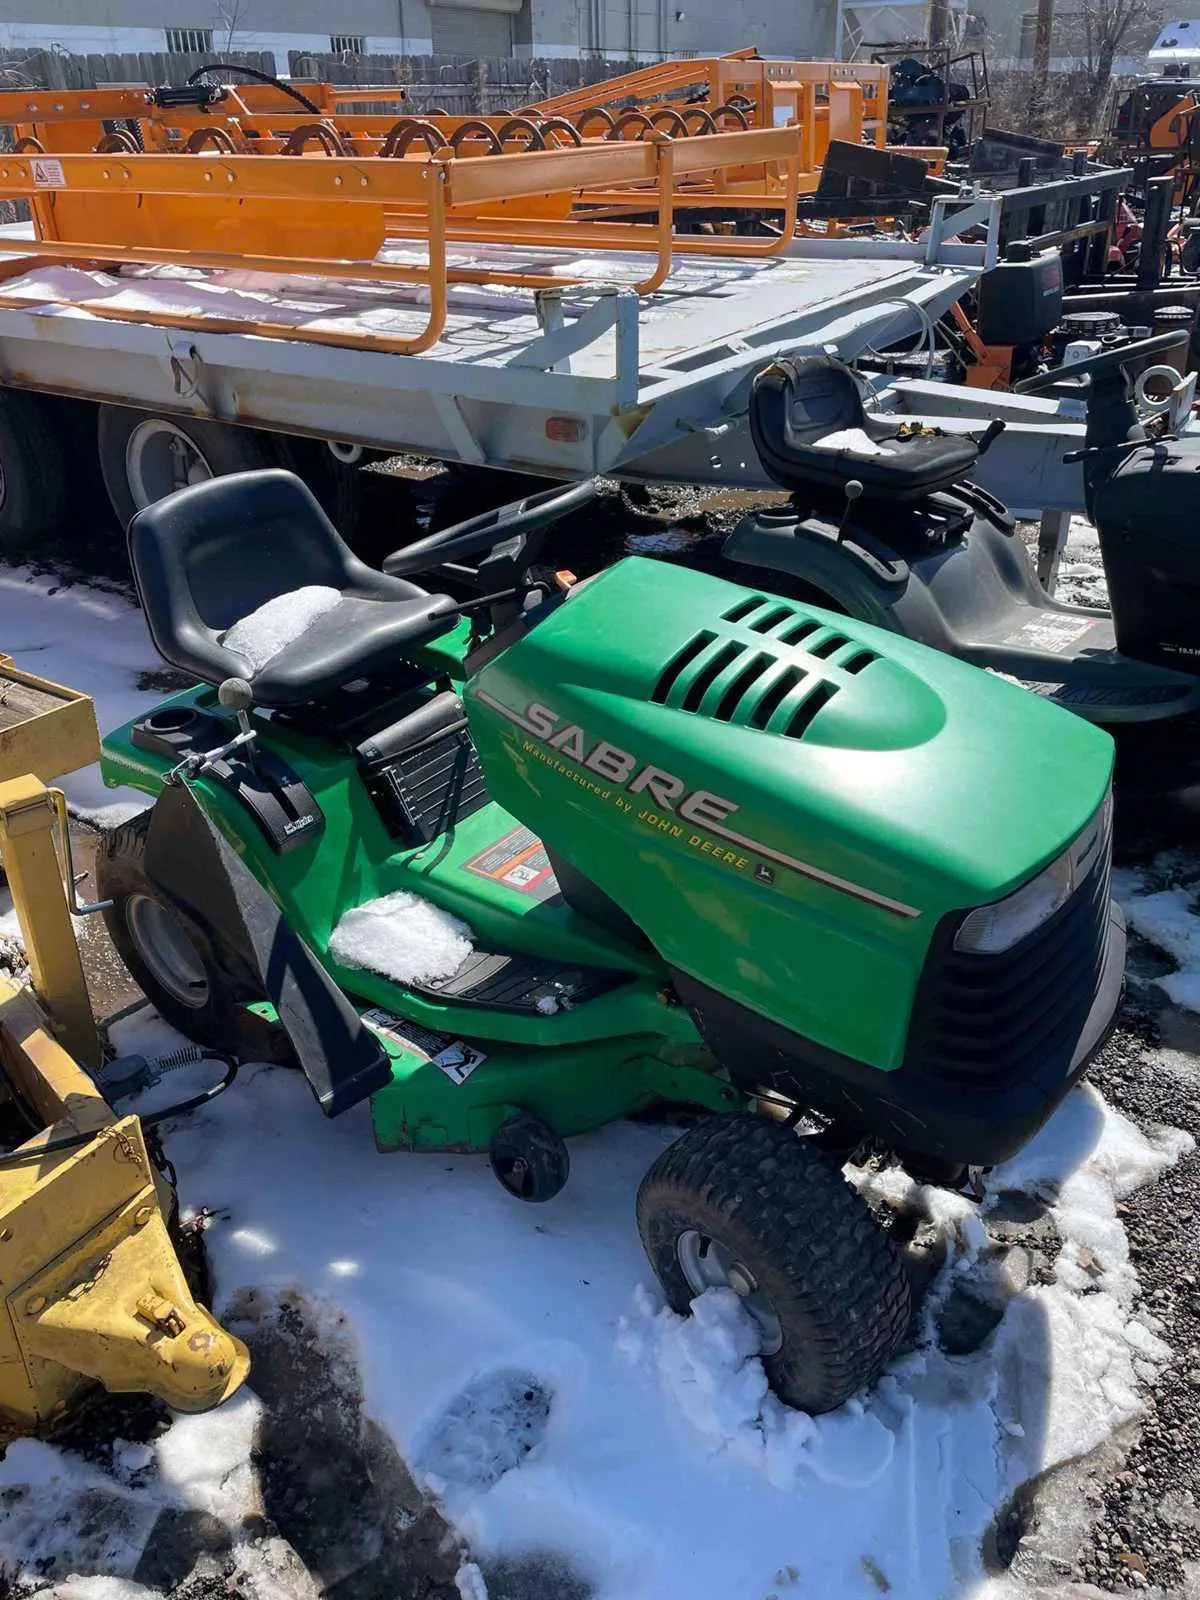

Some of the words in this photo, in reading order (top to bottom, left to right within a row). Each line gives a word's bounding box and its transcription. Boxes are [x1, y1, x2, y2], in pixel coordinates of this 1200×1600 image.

[522, 741, 611, 800] Manufactured
[615, 798, 632, 813] by
[638, 810, 684, 838] JOHN
[688, 835, 749, 869] DEERE
[526, 703, 739, 827] SABRE
